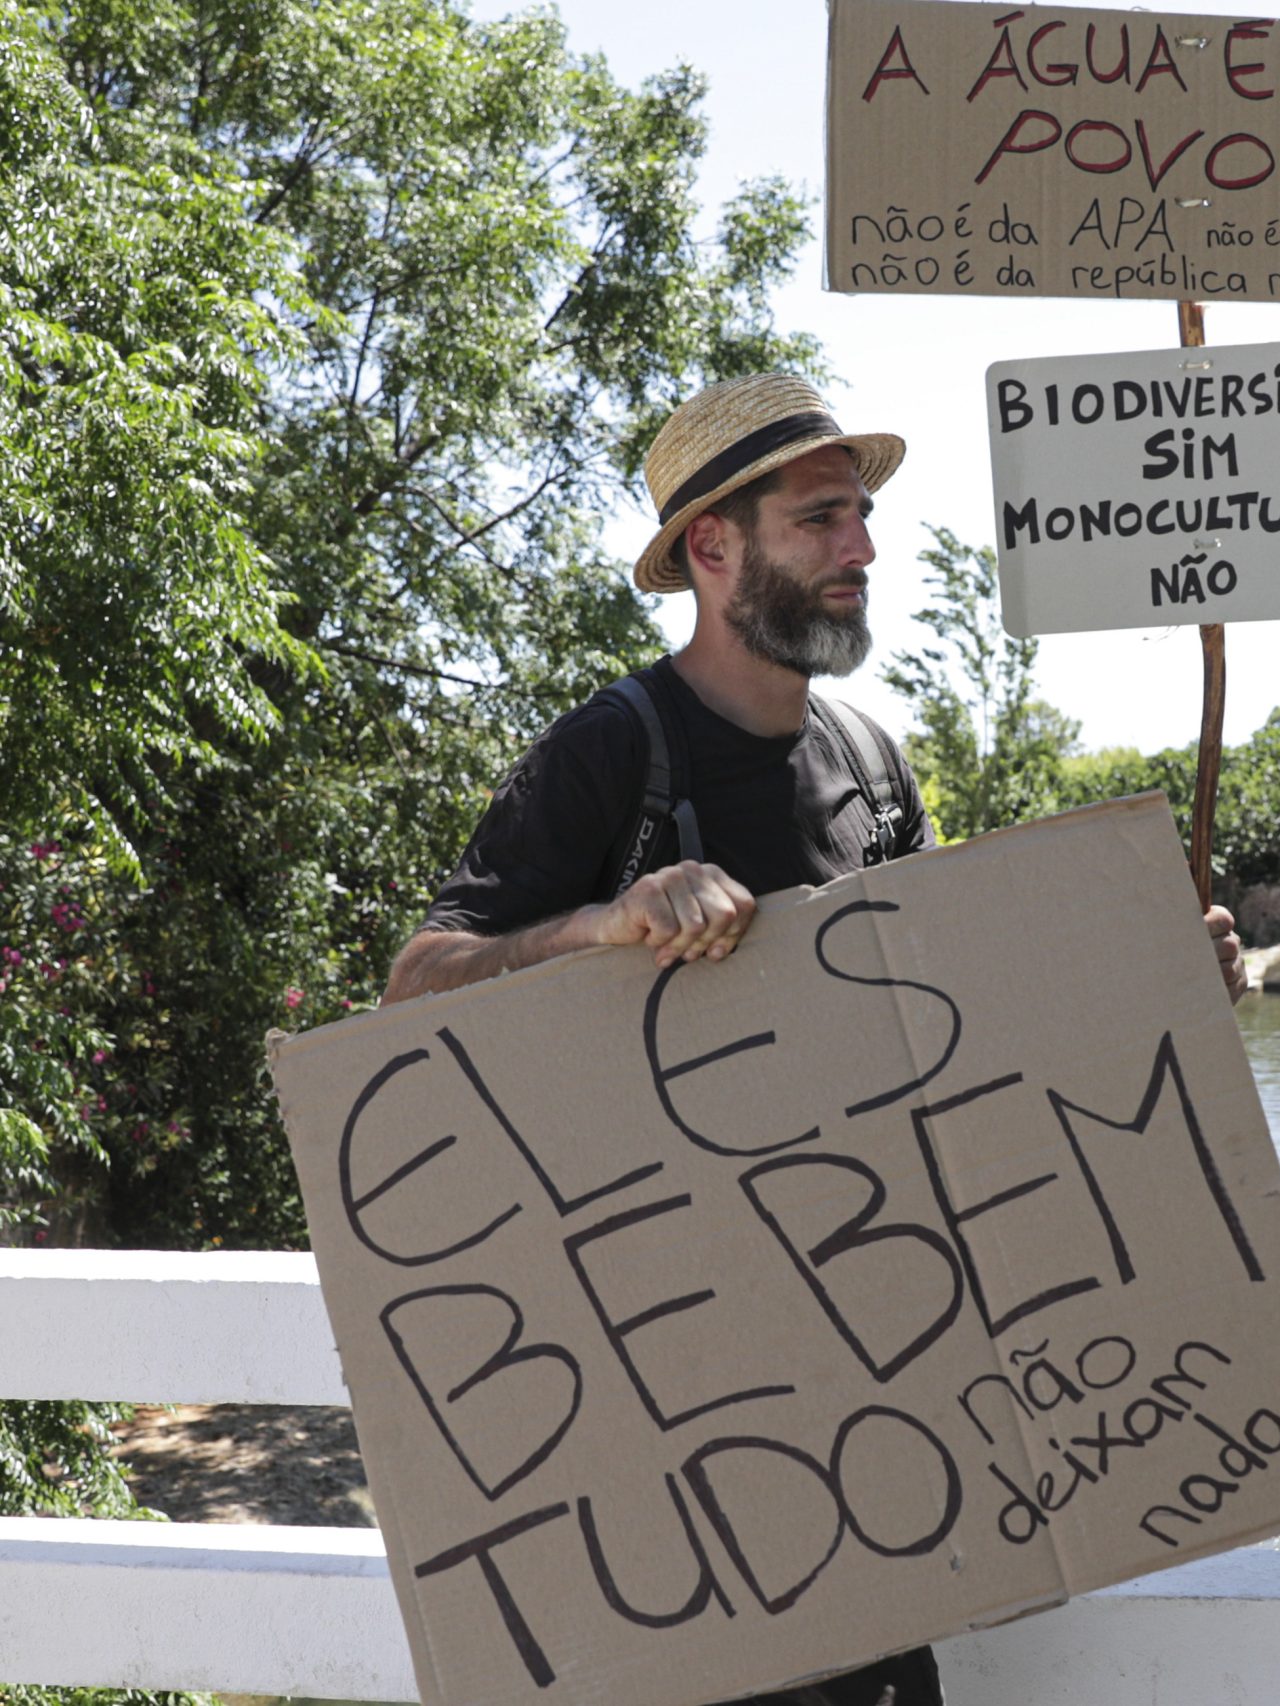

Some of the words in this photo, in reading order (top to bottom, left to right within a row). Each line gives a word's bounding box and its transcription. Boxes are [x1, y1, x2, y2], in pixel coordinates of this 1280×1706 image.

[862, 24, 930, 101] A
[967, 11, 1187, 102] ÁGUA
[974, 109, 1275, 191] POVO
[851, 206, 944, 245] não
[953, 203, 973, 238] é
[988, 202, 1038, 245] da
[1068, 197, 1175, 252] APA
[1206, 221, 1254, 247] não
[1264, 219, 1280, 246] é
[851, 253, 941, 287] não
[953, 250, 975, 286] é
[996, 255, 1036, 287] da
[1071, 252, 1248, 298] república
[1150, 552, 1238, 607] NÃO
[616, 816, 655, 897] DAKIN
[338, 899, 963, 1267] ELES
[380, 1030, 1266, 1502] BEBEM
[957, 1335, 1137, 1445] não
[998, 1341, 1232, 1545] deixam
[415, 1405, 963, 1689] TUDO
